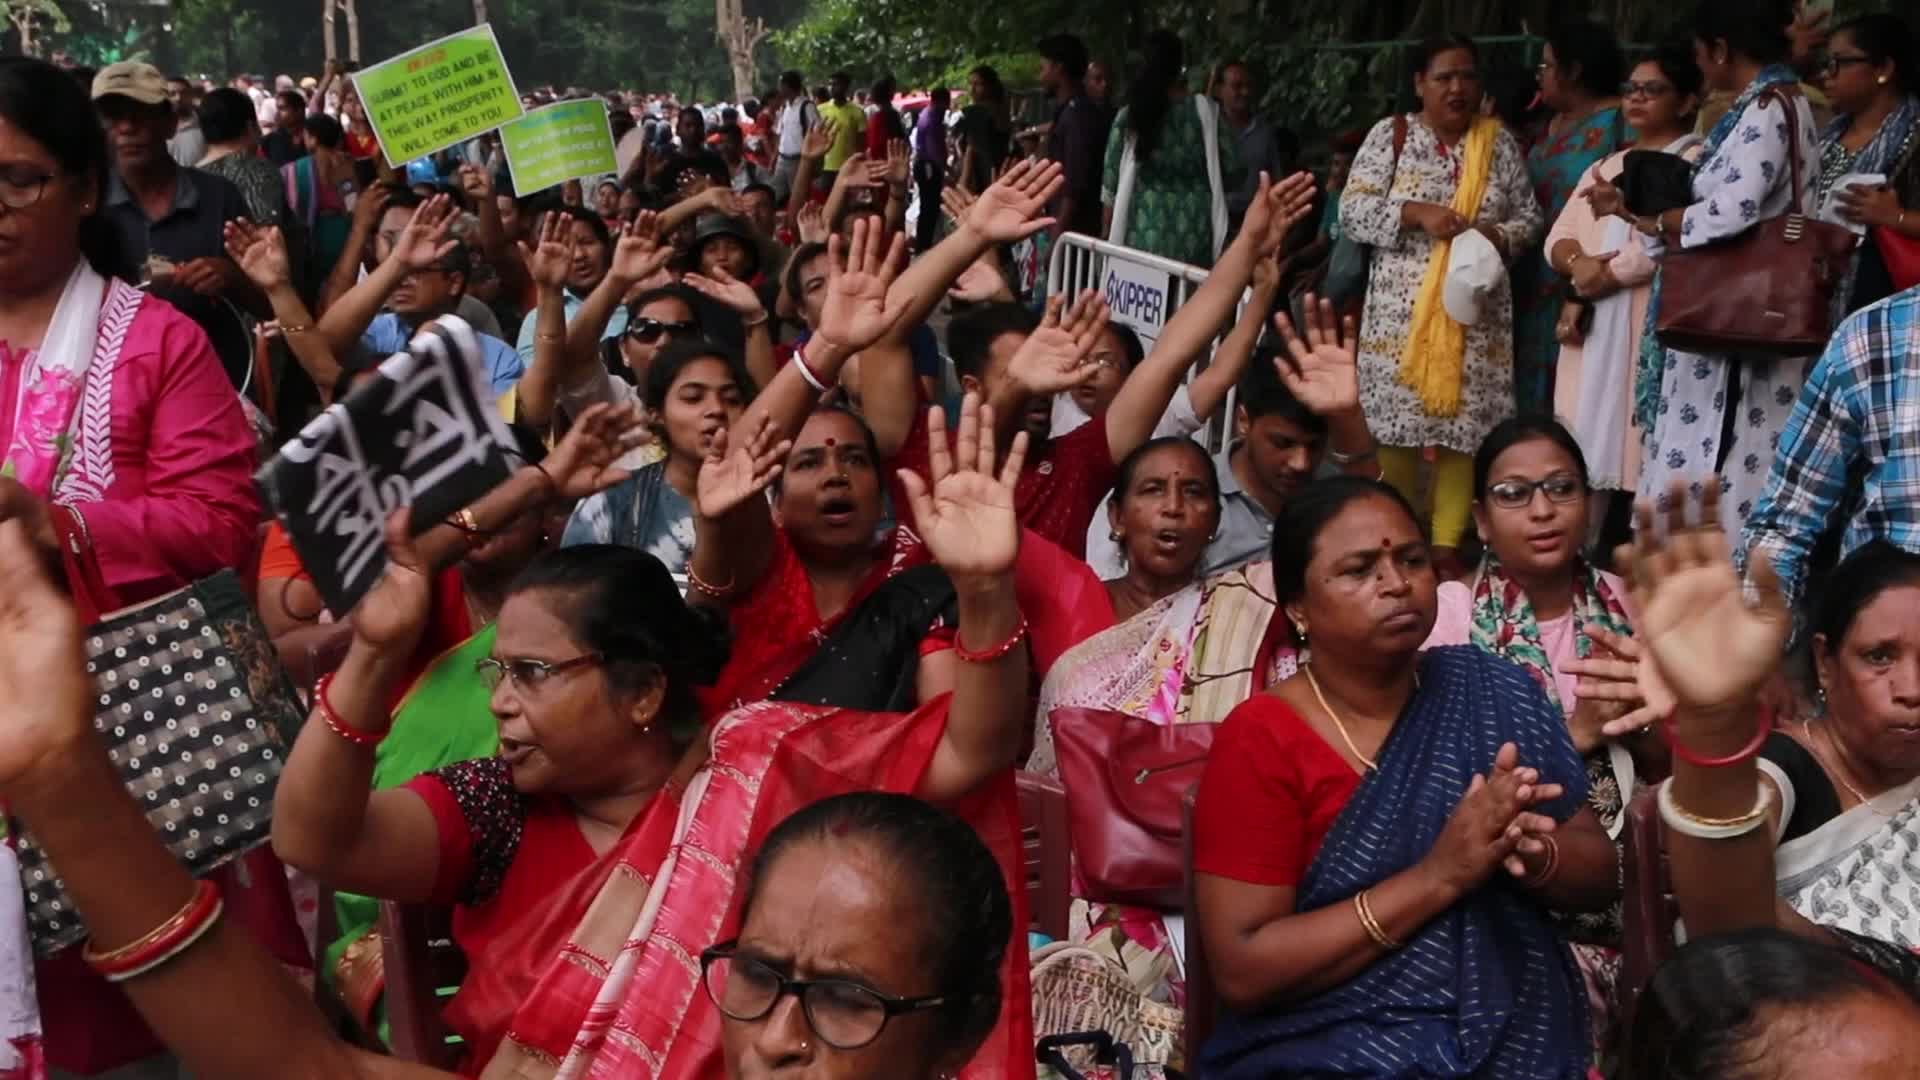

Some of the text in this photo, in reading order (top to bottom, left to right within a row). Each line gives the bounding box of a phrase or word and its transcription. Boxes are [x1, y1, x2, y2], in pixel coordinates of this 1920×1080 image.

[378, 66, 498, 122] AT PEACE WITH HIM IN
[411, 74, 427, 88] TO
[426, 65, 450, 82] GOD
[451, 55, 475, 73] AND
[413, 110, 438, 129] WAY
[439, 84, 504, 118] PROSPERITY
[400, 134, 429, 154] WILL
[430, 122, 459, 141] COME
[463, 113, 479, 128] TO
[1104, 270, 1162, 328] SKIPPER
